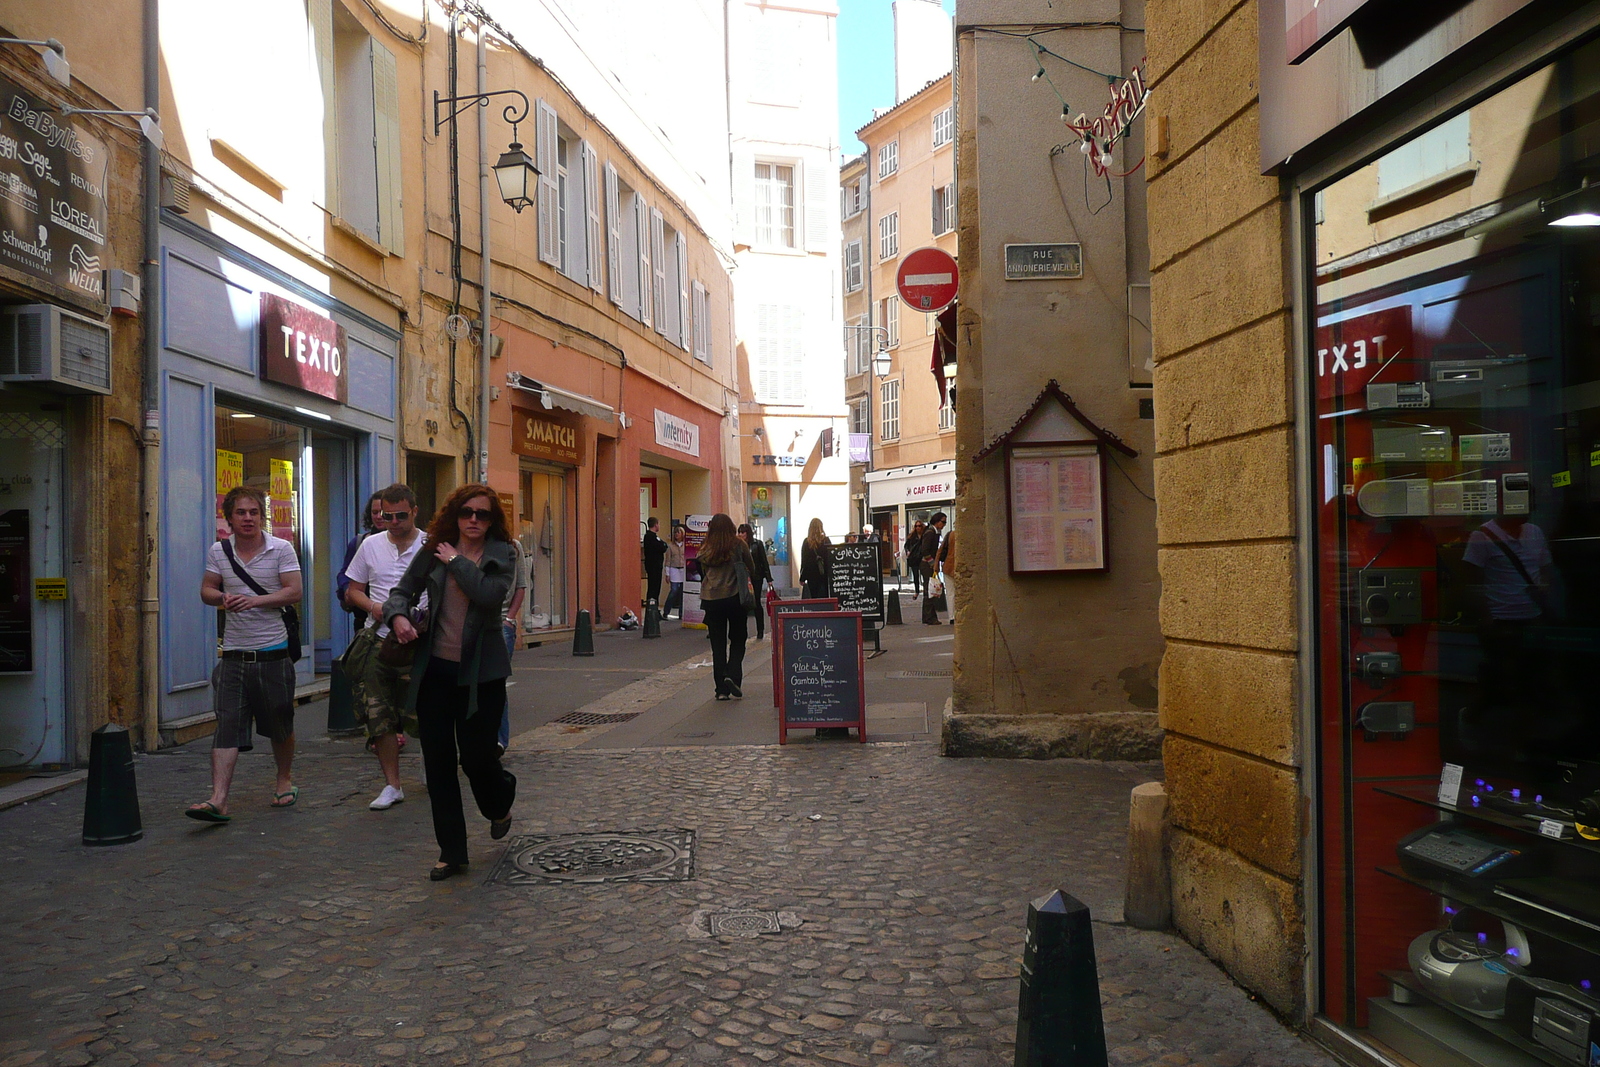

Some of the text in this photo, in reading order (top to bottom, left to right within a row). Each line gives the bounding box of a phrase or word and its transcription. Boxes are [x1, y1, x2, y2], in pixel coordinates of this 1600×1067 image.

[8, 94, 94, 164] BaByliss
[18, 141, 52, 178] Sage
[70, 172, 103, 199] REVLON
[50, 197, 104, 238] L'ORÉAL
[2, 248, 53, 275] PROFESSIONAL
[1033, 250, 1053, 259] RUE
[69, 267, 100, 295] WELLA
[281, 325, 341, 377] TEXTO
[526, 418, 575, 449] SMATCH
[663, 415, 693, 451] internity
[752, 455, 807, 467] IKKS
[913, 484, 942, 495] CAP FREE
[792, 662, 810, 673] Plat
